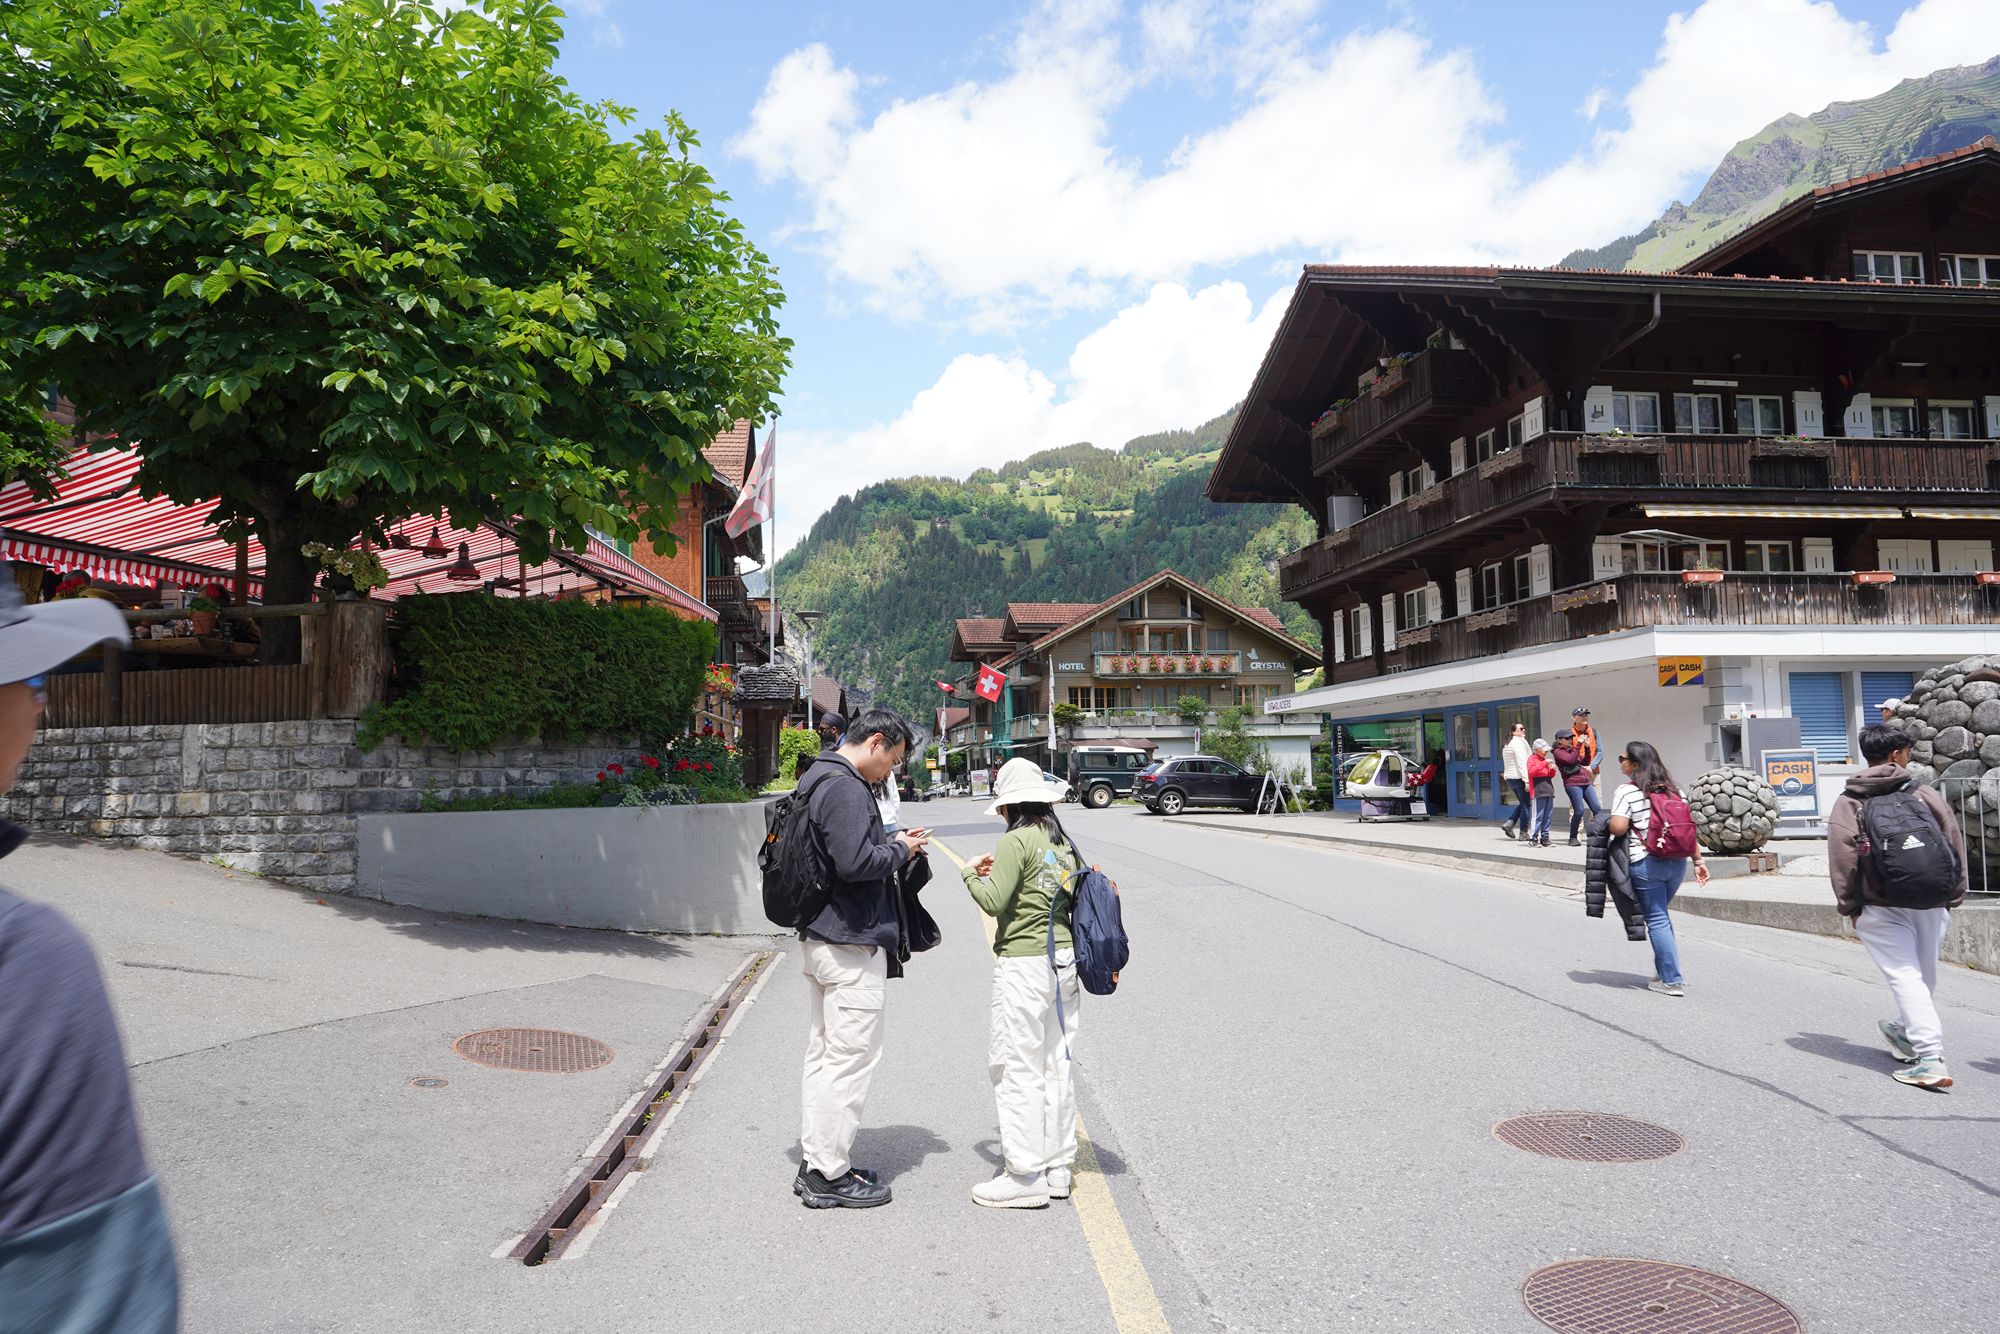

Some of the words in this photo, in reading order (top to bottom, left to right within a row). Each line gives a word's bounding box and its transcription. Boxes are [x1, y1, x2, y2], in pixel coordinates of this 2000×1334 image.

[1058, 662, 1086, 670] HOTEL
[1250, 661, 1287, 670] CRYSTAL
[1659, 665, 1676, 673] CASH
[1771, 764, 1809, 774] CASH
